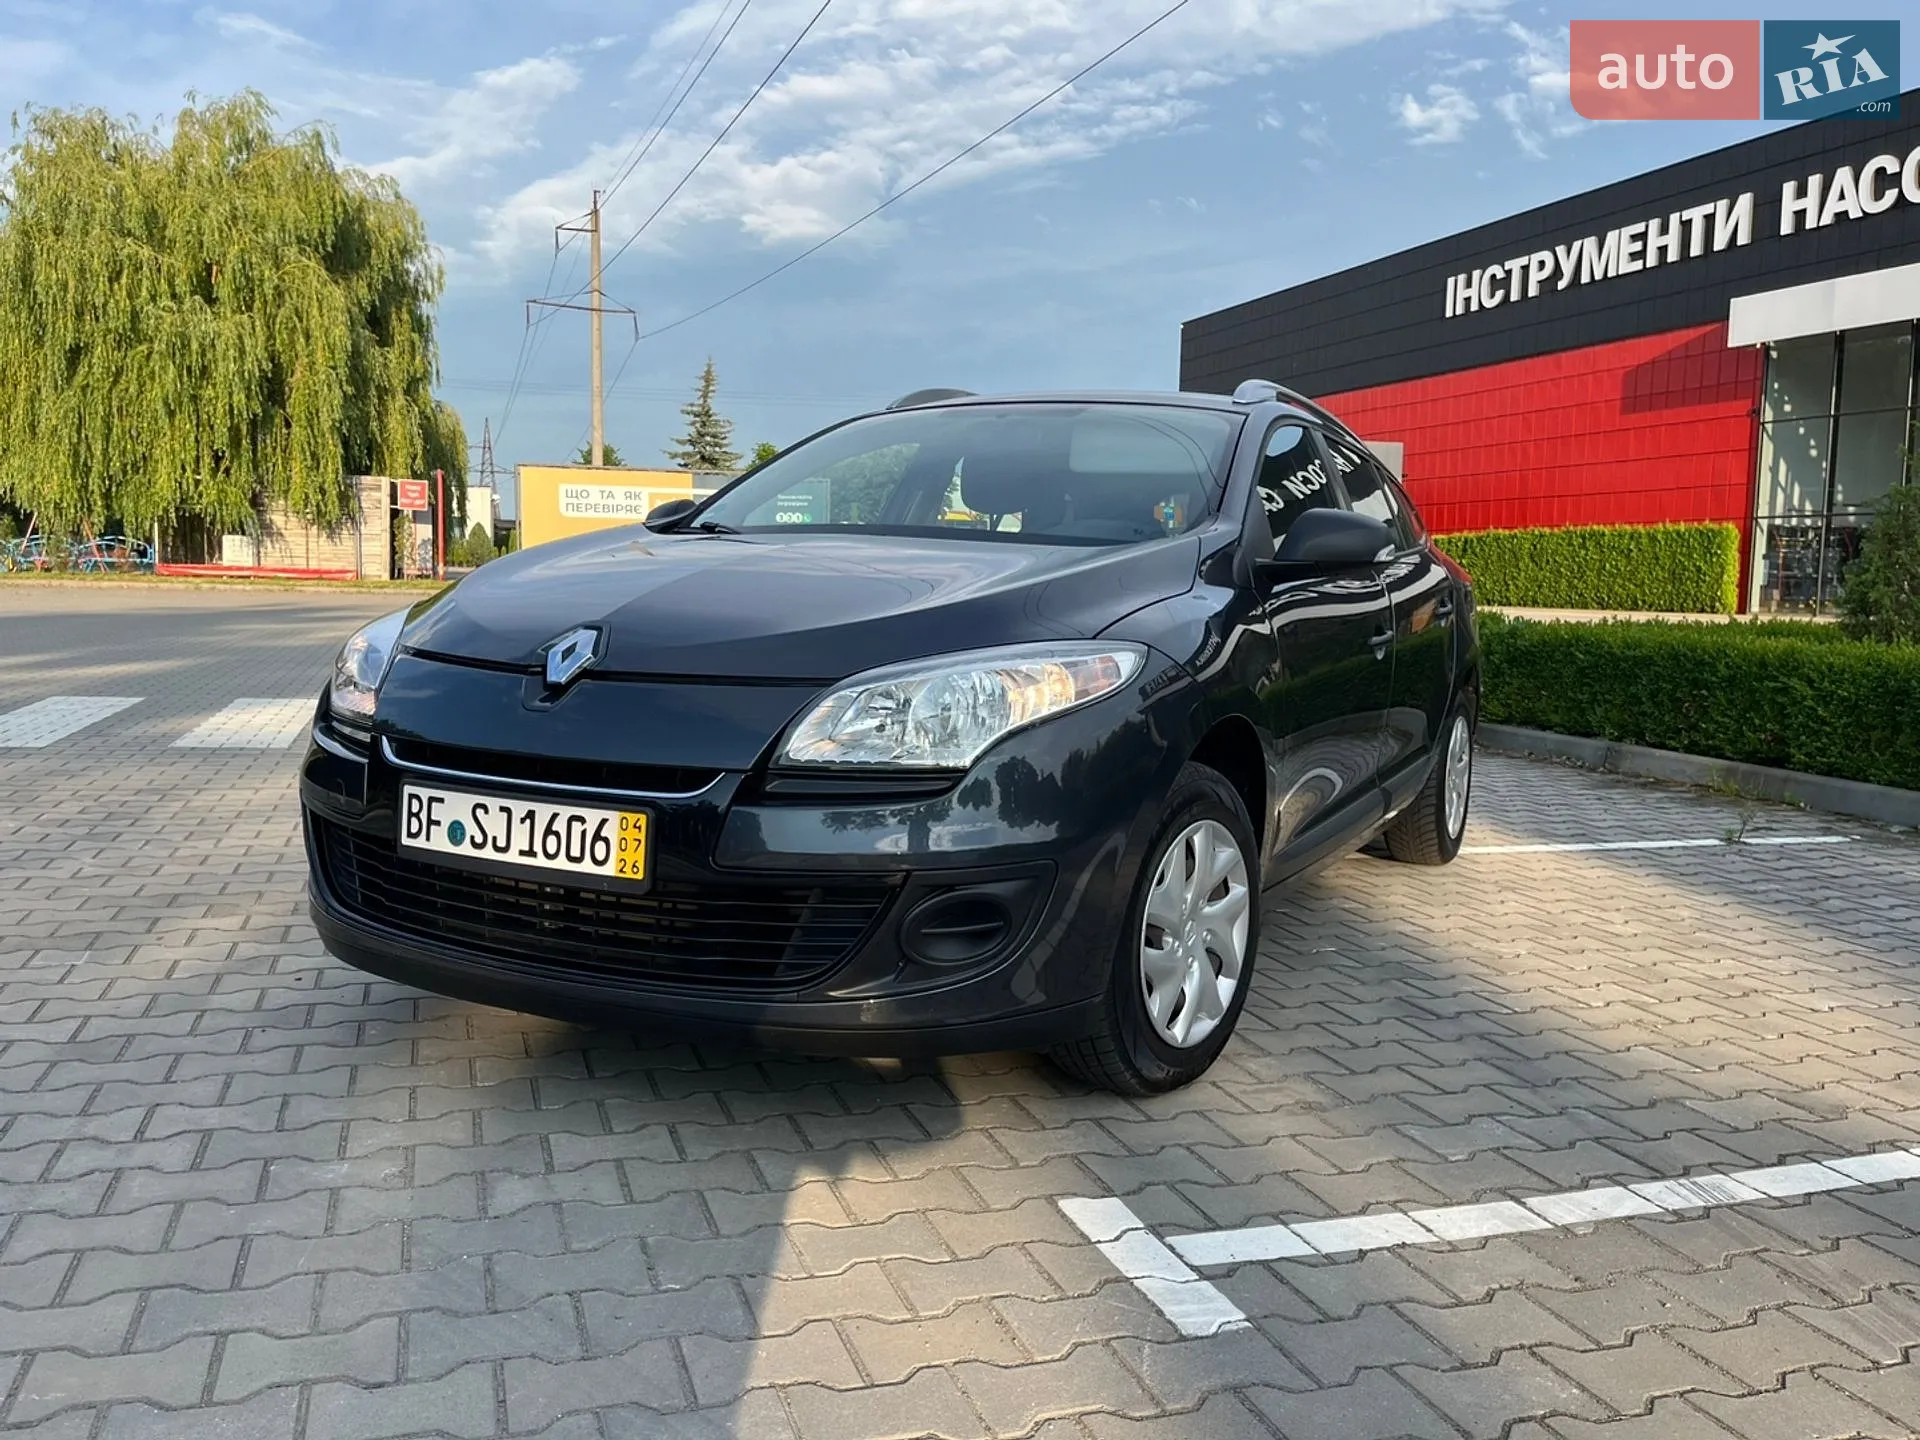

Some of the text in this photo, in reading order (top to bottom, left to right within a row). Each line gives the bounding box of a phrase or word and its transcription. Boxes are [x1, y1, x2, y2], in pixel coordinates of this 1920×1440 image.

[1445, 192, 1754, 318] ІНСТРУМЕНТИ
[565, 488, 643, 501] ЩО ТА ЯК
[565, 502, 643, 515] ПЕРЕВІРЯЄ
[407, 793, 445, 842] BF
[619, 816, 642, 833] 04
[619, 837, 642, 853] 07
[618, 858, 640, 875] 26
